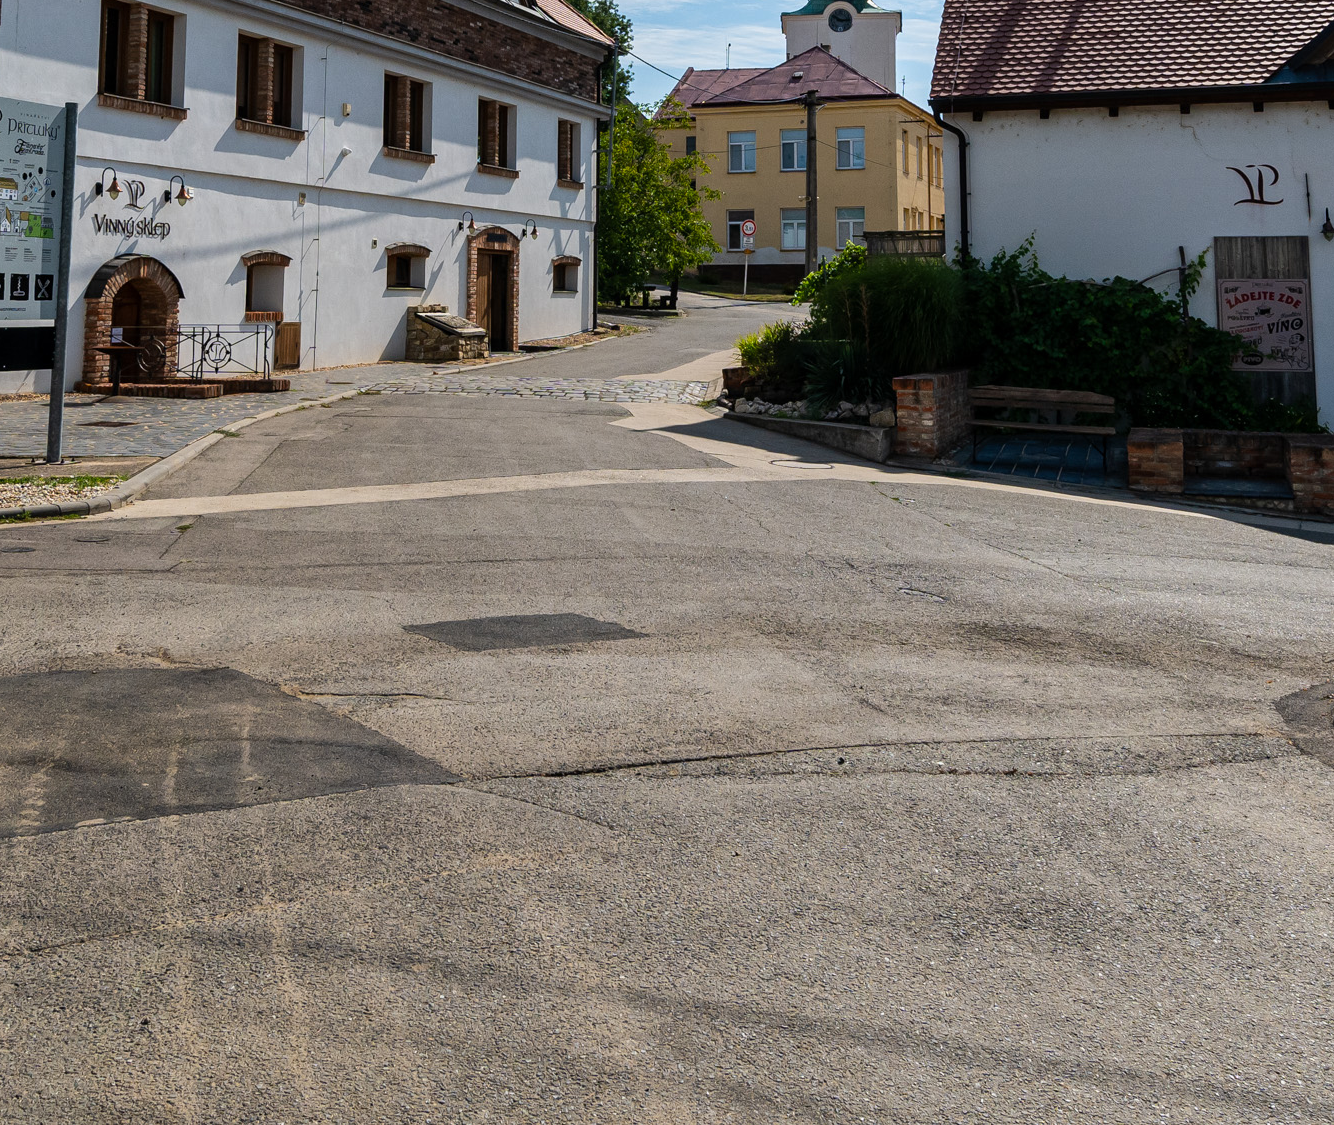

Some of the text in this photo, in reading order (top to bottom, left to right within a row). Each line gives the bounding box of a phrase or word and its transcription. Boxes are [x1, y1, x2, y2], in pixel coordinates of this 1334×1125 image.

[1225, 291, 1302, 310] ŽÁDEJTE ZDE
[1267, 318, 1303, 334] VÍNO
